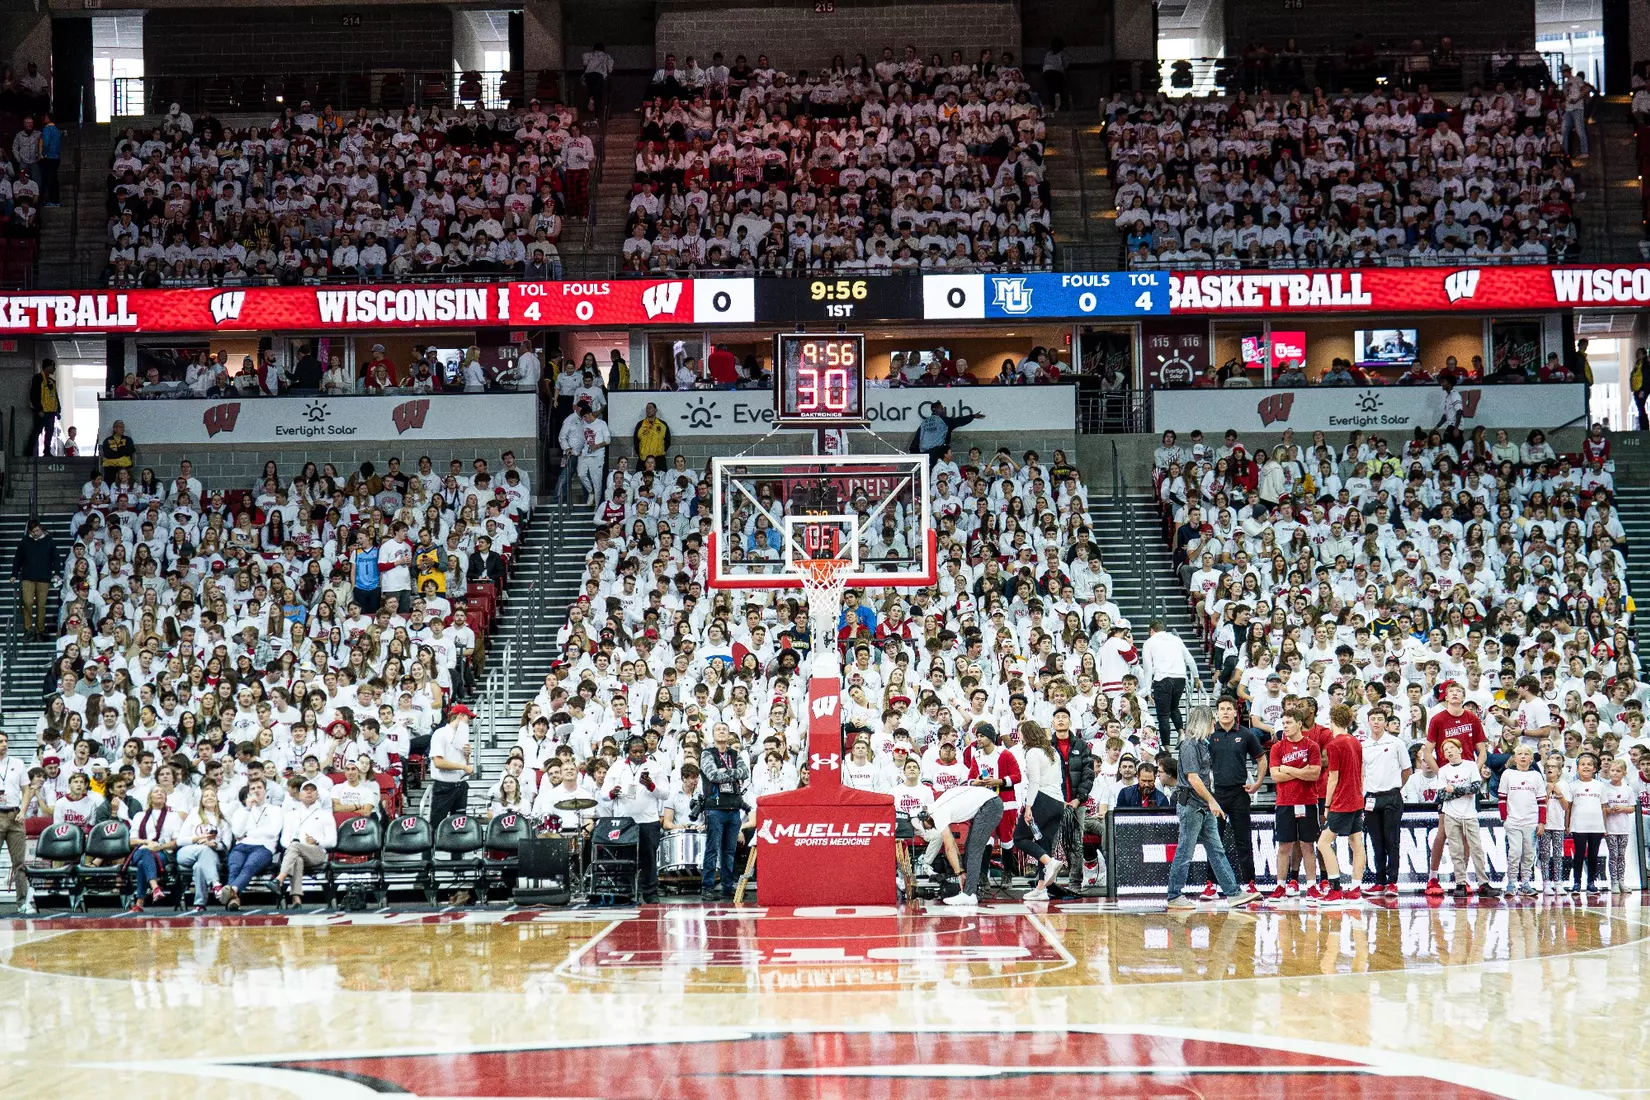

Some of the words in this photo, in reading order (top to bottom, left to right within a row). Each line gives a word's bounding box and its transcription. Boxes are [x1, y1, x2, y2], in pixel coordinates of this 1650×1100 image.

[815, 3, 834, 12] 215
[342, 17, 360, 26] 214
[1062, 274, 1110, 287] FOULS
[1128, 273, 1159, 286] TOL
[517, 283, 548, 296] TOL
[562, 282, 610, 296] FOULS
[811, 281, 868, 301] 9:56
[712, 291, 732, 313] 0
[947, 287, 966, 309] 0
[1079, 292, 1097, 312] 0
[1134, 292, 1153, 311] 4
[316, 288, 488, 323] WISCONSIN
[524, 302, 542, 321] 4
[576, 301, 594, 321] 0
[826, 304, 854, 317] 1ST
[1152, 337, 1169, 347] 115
[1182, 337, 1199, 347] 116
[502, 348, 519, 358] 114
[803, 342, 854, 367] 9:56
[798, 368, 848, 410] 30
[867, 402, 912, 421] olar
[1329, 415, 1379, 428] Everlight
[1380, 414, 1410, 425] Solar
[275, 424, 325, 438] Everlight
[327, 424, 358, 436] Solar
[812, 695, 838, 720] W
[794, 837, 829, 847] SPORTS
[829, 837, 871, 846] MEDICINE
